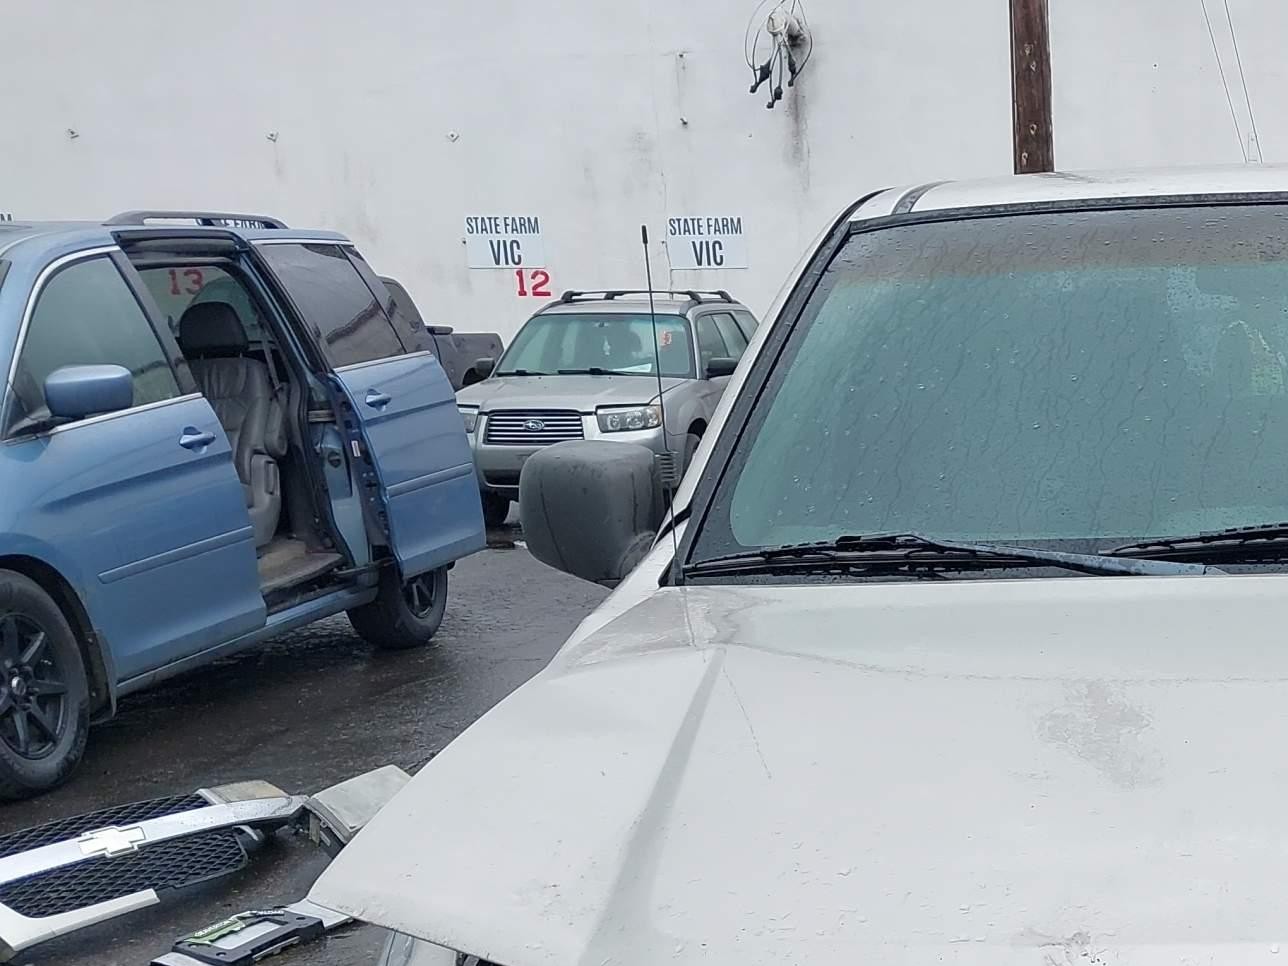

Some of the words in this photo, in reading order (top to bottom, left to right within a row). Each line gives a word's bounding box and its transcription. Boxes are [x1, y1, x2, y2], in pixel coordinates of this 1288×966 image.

[466, 216, 501, 234] STATE
[503, 216, 540, 234] FARM
[668, 217, 704, 236] STATE
[706, 217, 742, 235] FARM
[489, 239, 522, 266] VIC
[691, 240, 724, 266] VIC
[168, 269, 204, 295] 13
[516, 269, 552, 297] 12
